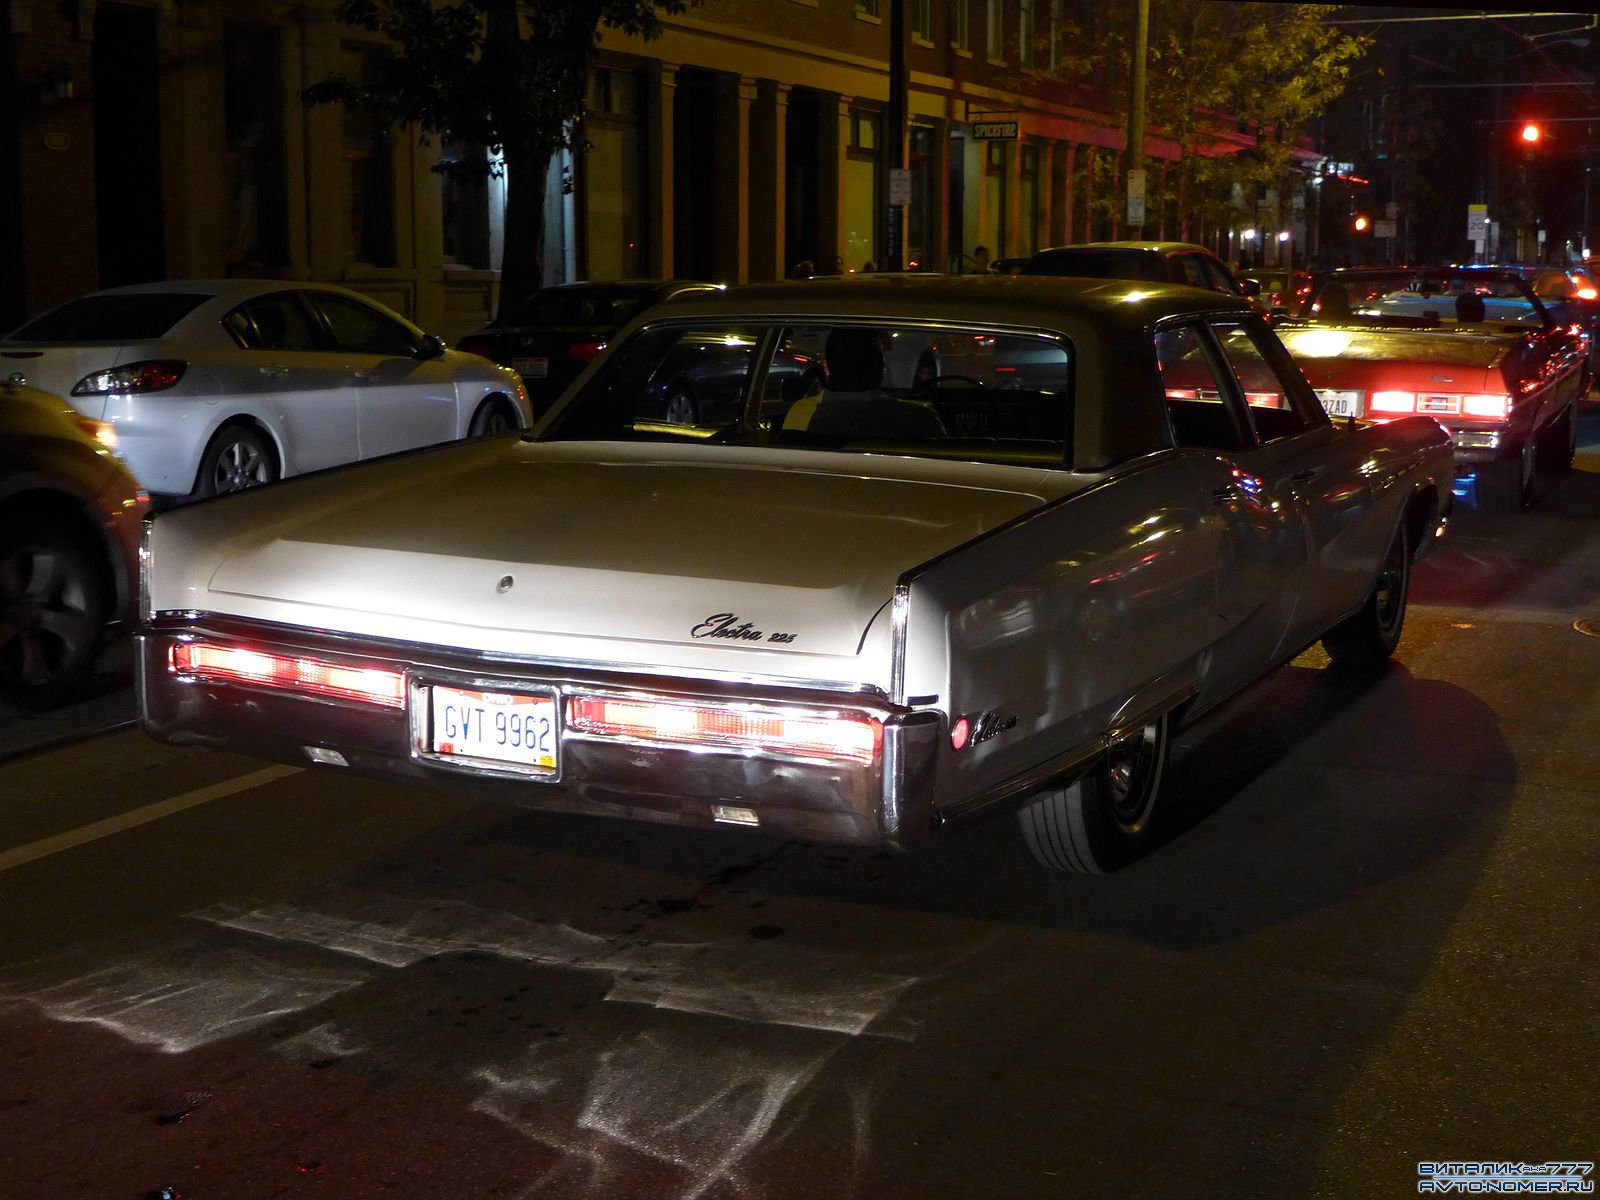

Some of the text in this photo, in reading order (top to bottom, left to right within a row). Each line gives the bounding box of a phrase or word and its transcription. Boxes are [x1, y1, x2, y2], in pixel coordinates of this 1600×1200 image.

[691, 613, 797, 643] Electra 225
[445, 705, 550, 752] GVT 9962
